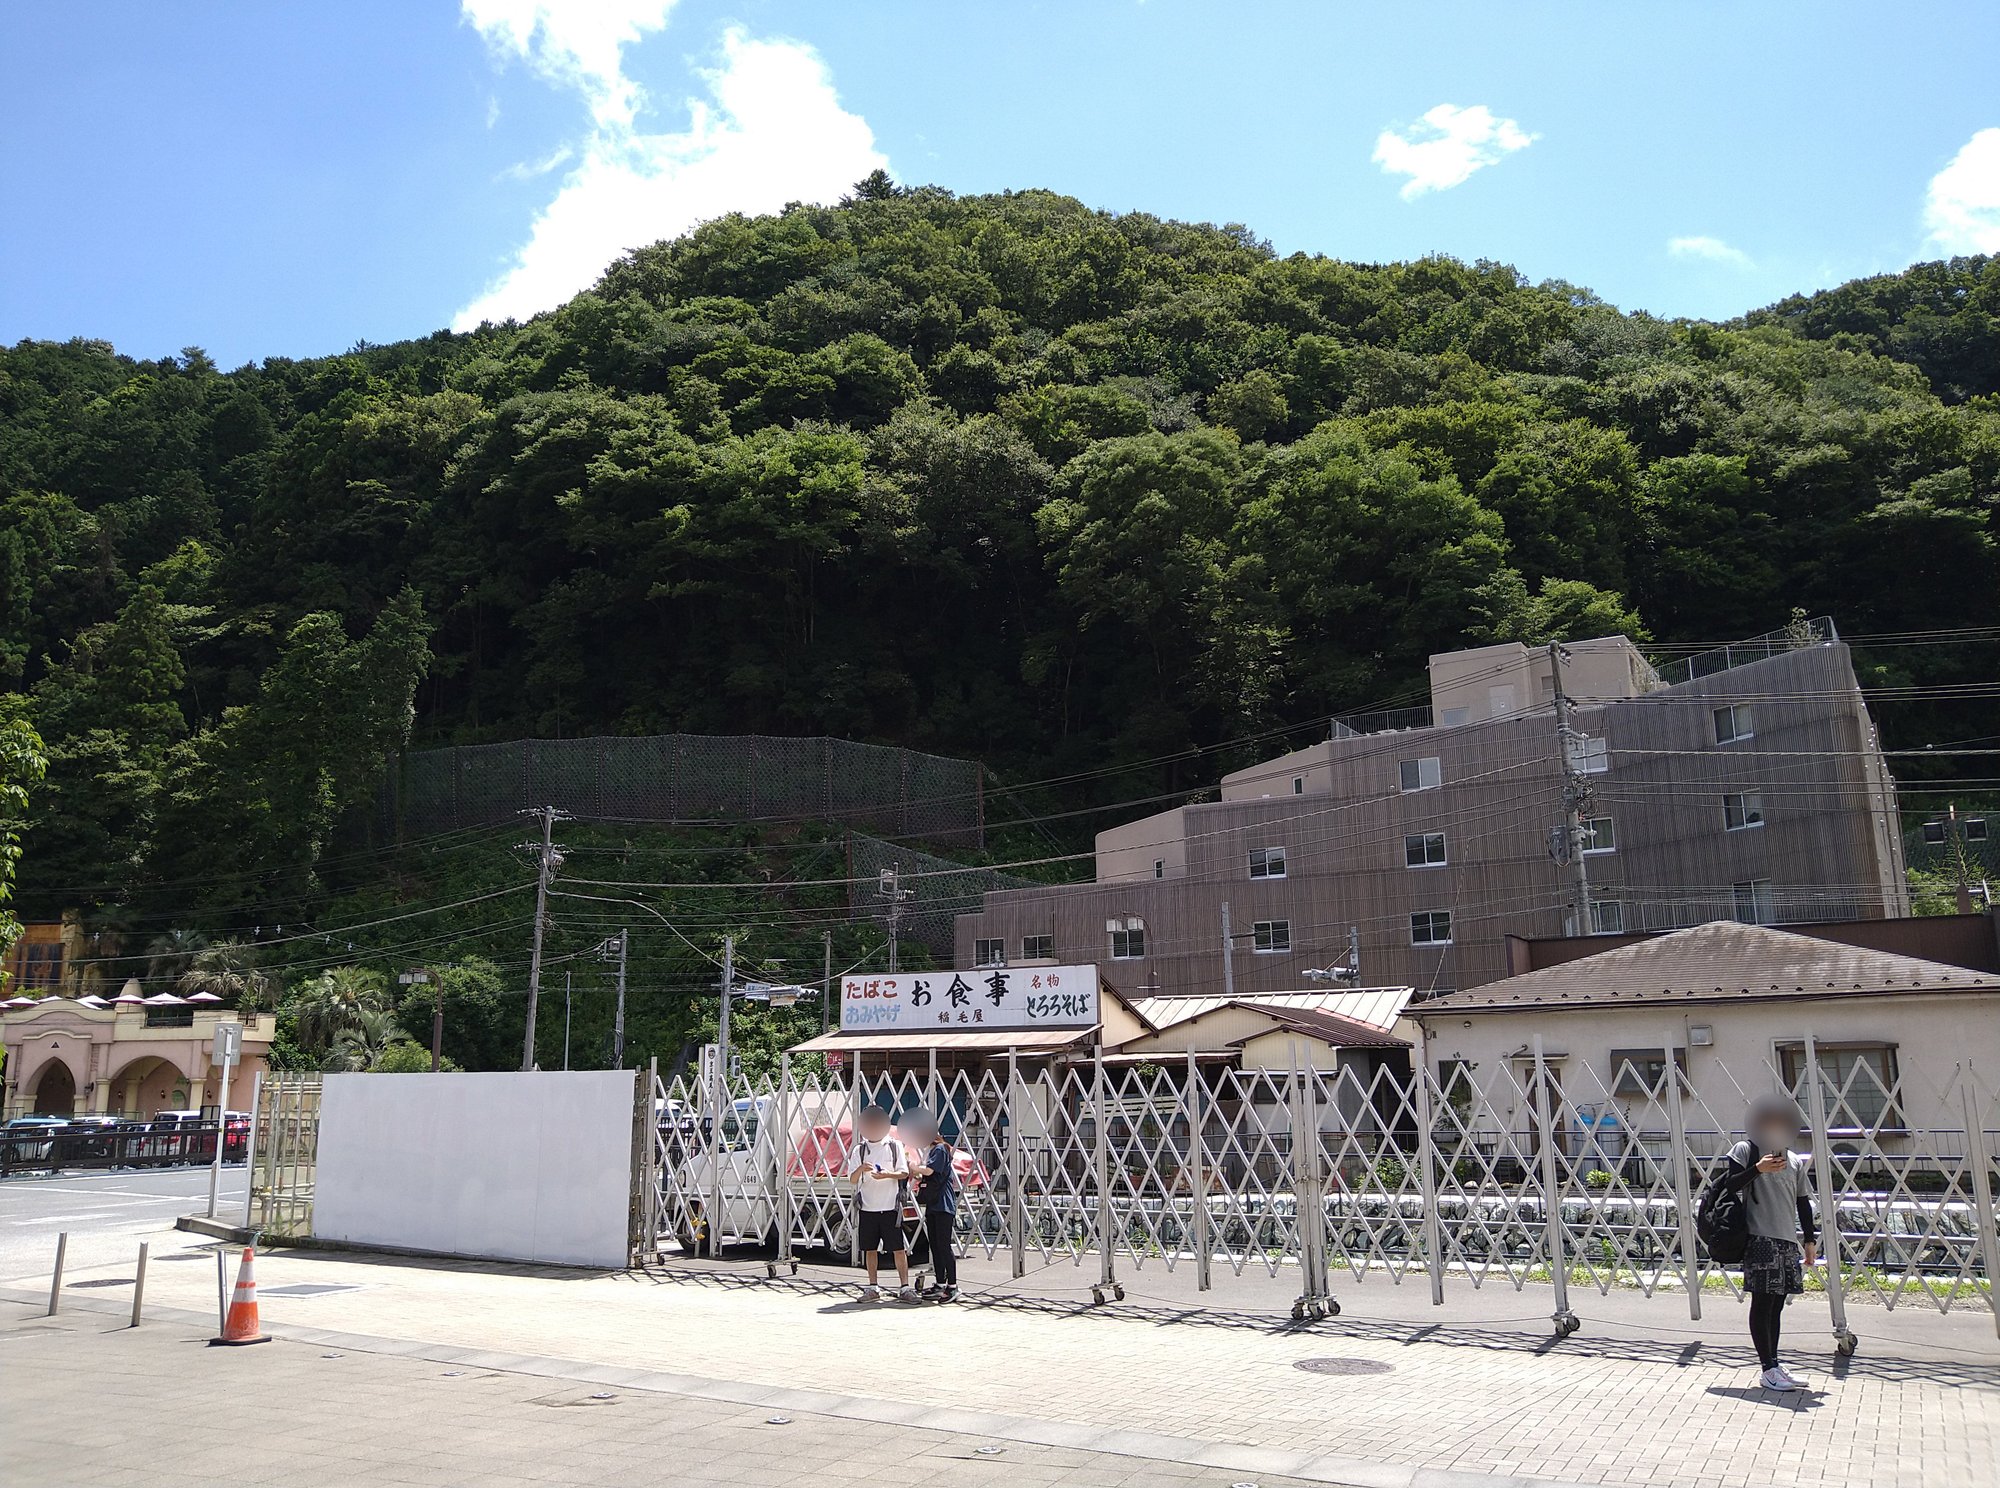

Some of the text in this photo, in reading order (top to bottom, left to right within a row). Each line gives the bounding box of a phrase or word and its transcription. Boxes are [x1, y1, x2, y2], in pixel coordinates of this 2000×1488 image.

[846, 980, 898, 999] たばこ
[911, 971, 1010, 1008] お食事
[1031, 973, 1060, 989] 名物
[846, 1003, 901, 1024] おみやげ
[1027, 993, 1091, 1018] とろろそば
[938, 1008, 984, 1024] 稲毛屋
